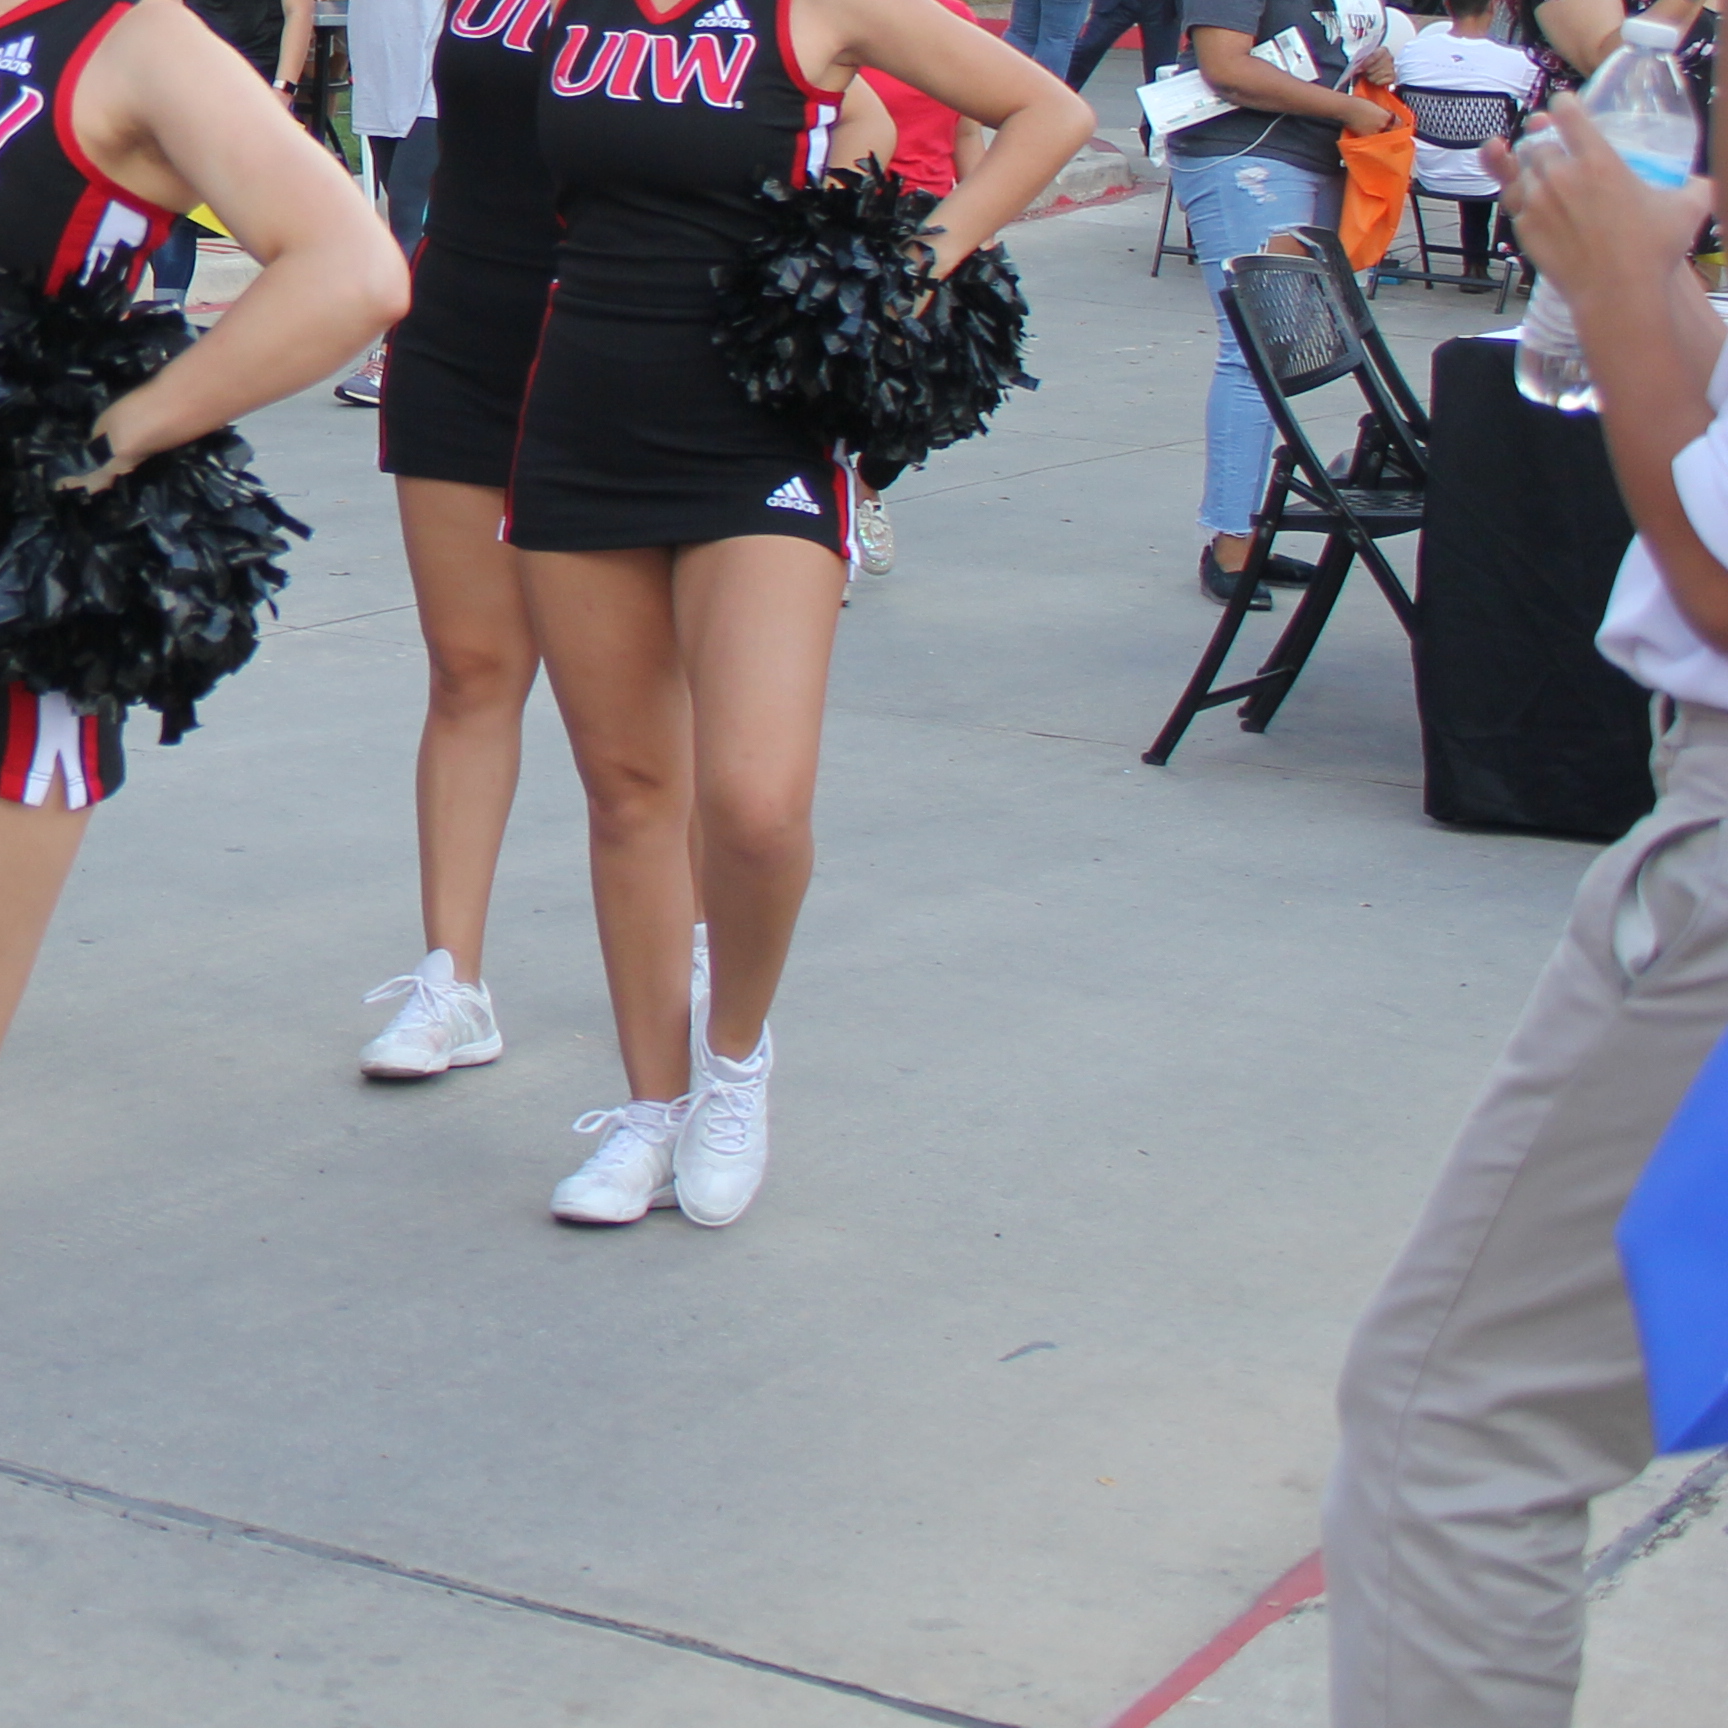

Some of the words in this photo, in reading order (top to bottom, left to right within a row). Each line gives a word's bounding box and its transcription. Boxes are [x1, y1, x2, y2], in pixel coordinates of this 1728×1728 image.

[694, 18, 750, 30] adidas
[551, 25, 756, 108] UIW
[766, 496, 821, 515] adidas
